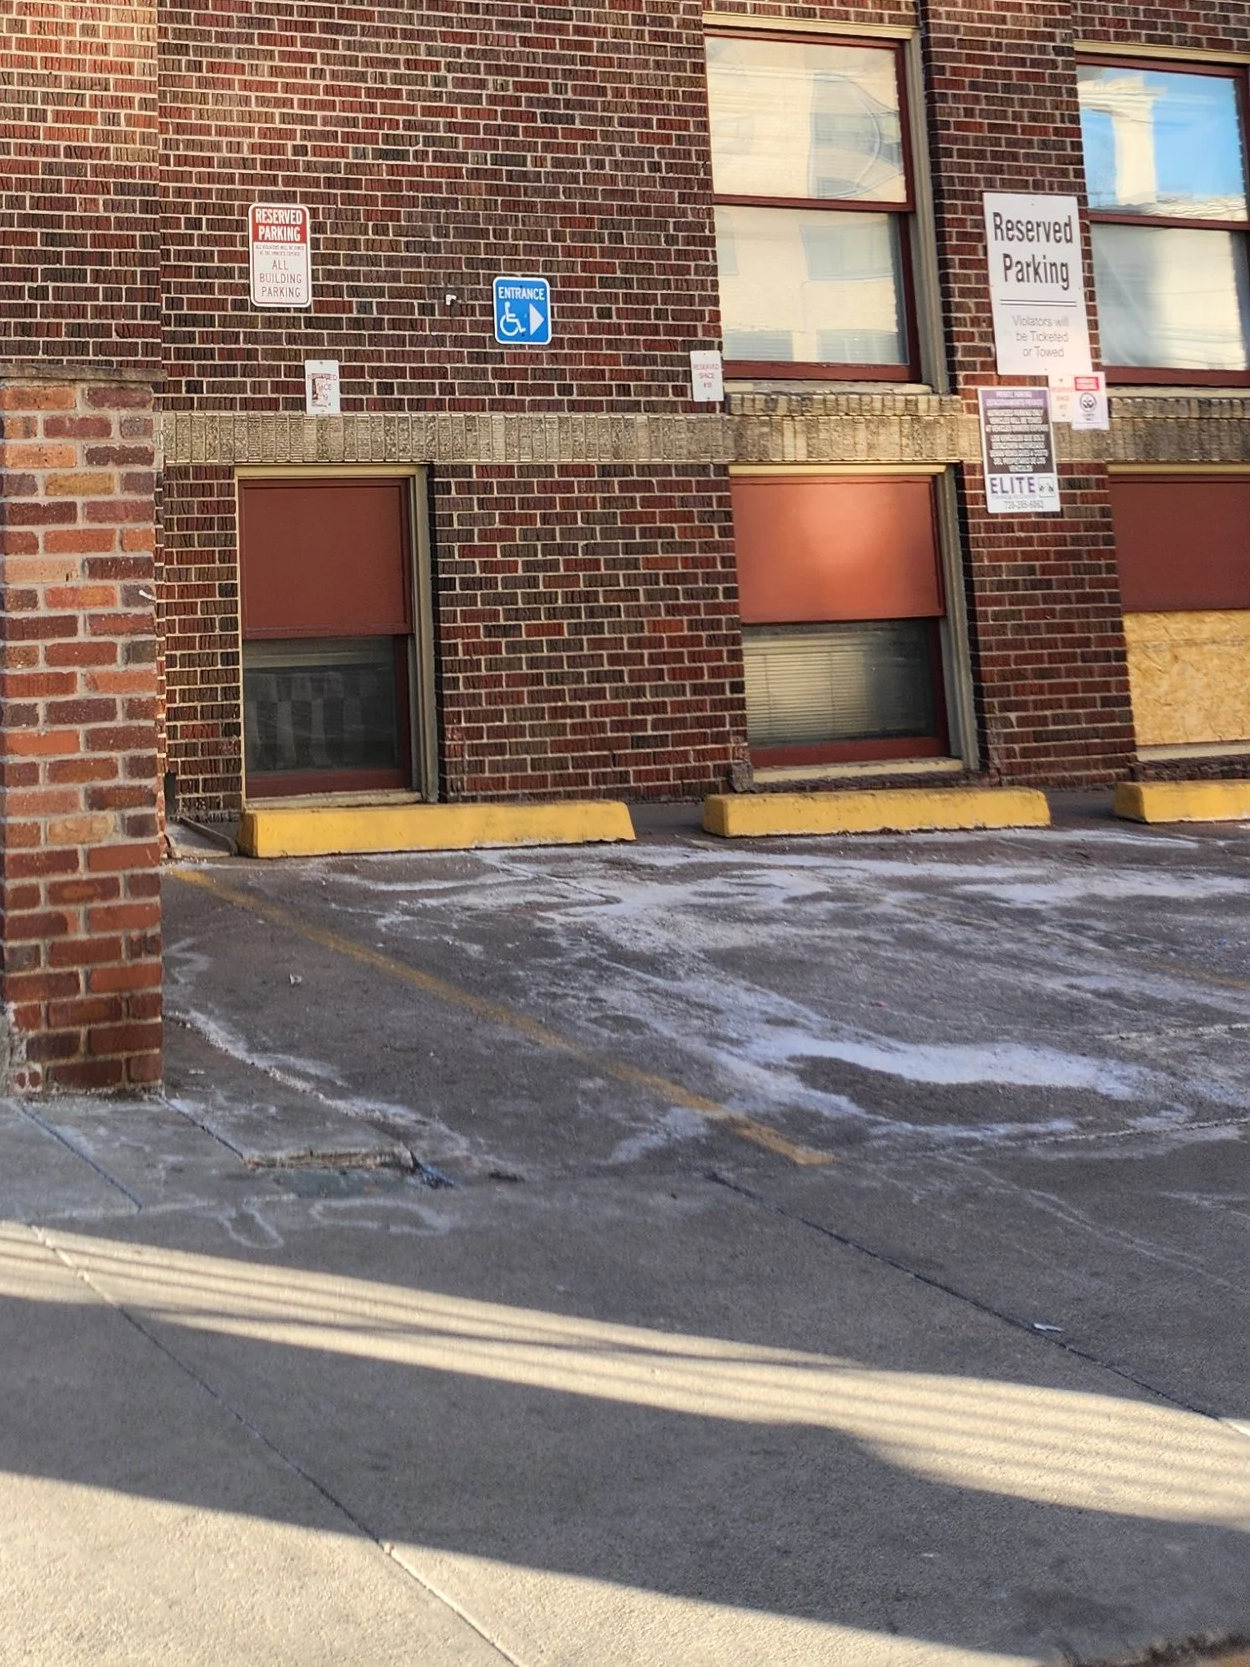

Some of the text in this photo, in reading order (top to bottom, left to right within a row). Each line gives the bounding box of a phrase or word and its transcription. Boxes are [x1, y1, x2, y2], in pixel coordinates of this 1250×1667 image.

[255, 208, 303, 224] RESERVED
[258, 225, 301, 242] PARKING
[993, 212, 1073, 244] Reserved
[271, 259, 289, 271] ALL
[259, 272, 302, 284] BUILDING
[1002, 253, 1070, 291] Parking
[261, 286, 301, 298] PARKING
[498, 287, 545, 301] ENTRANCE
[1011, 314, 1069, 326] Violators will
[1016, 330, 1069, 342] be Ticketed
[1023, 345, 1065, 357] or Towed
[990, 477, 1037, 494] ELITE
